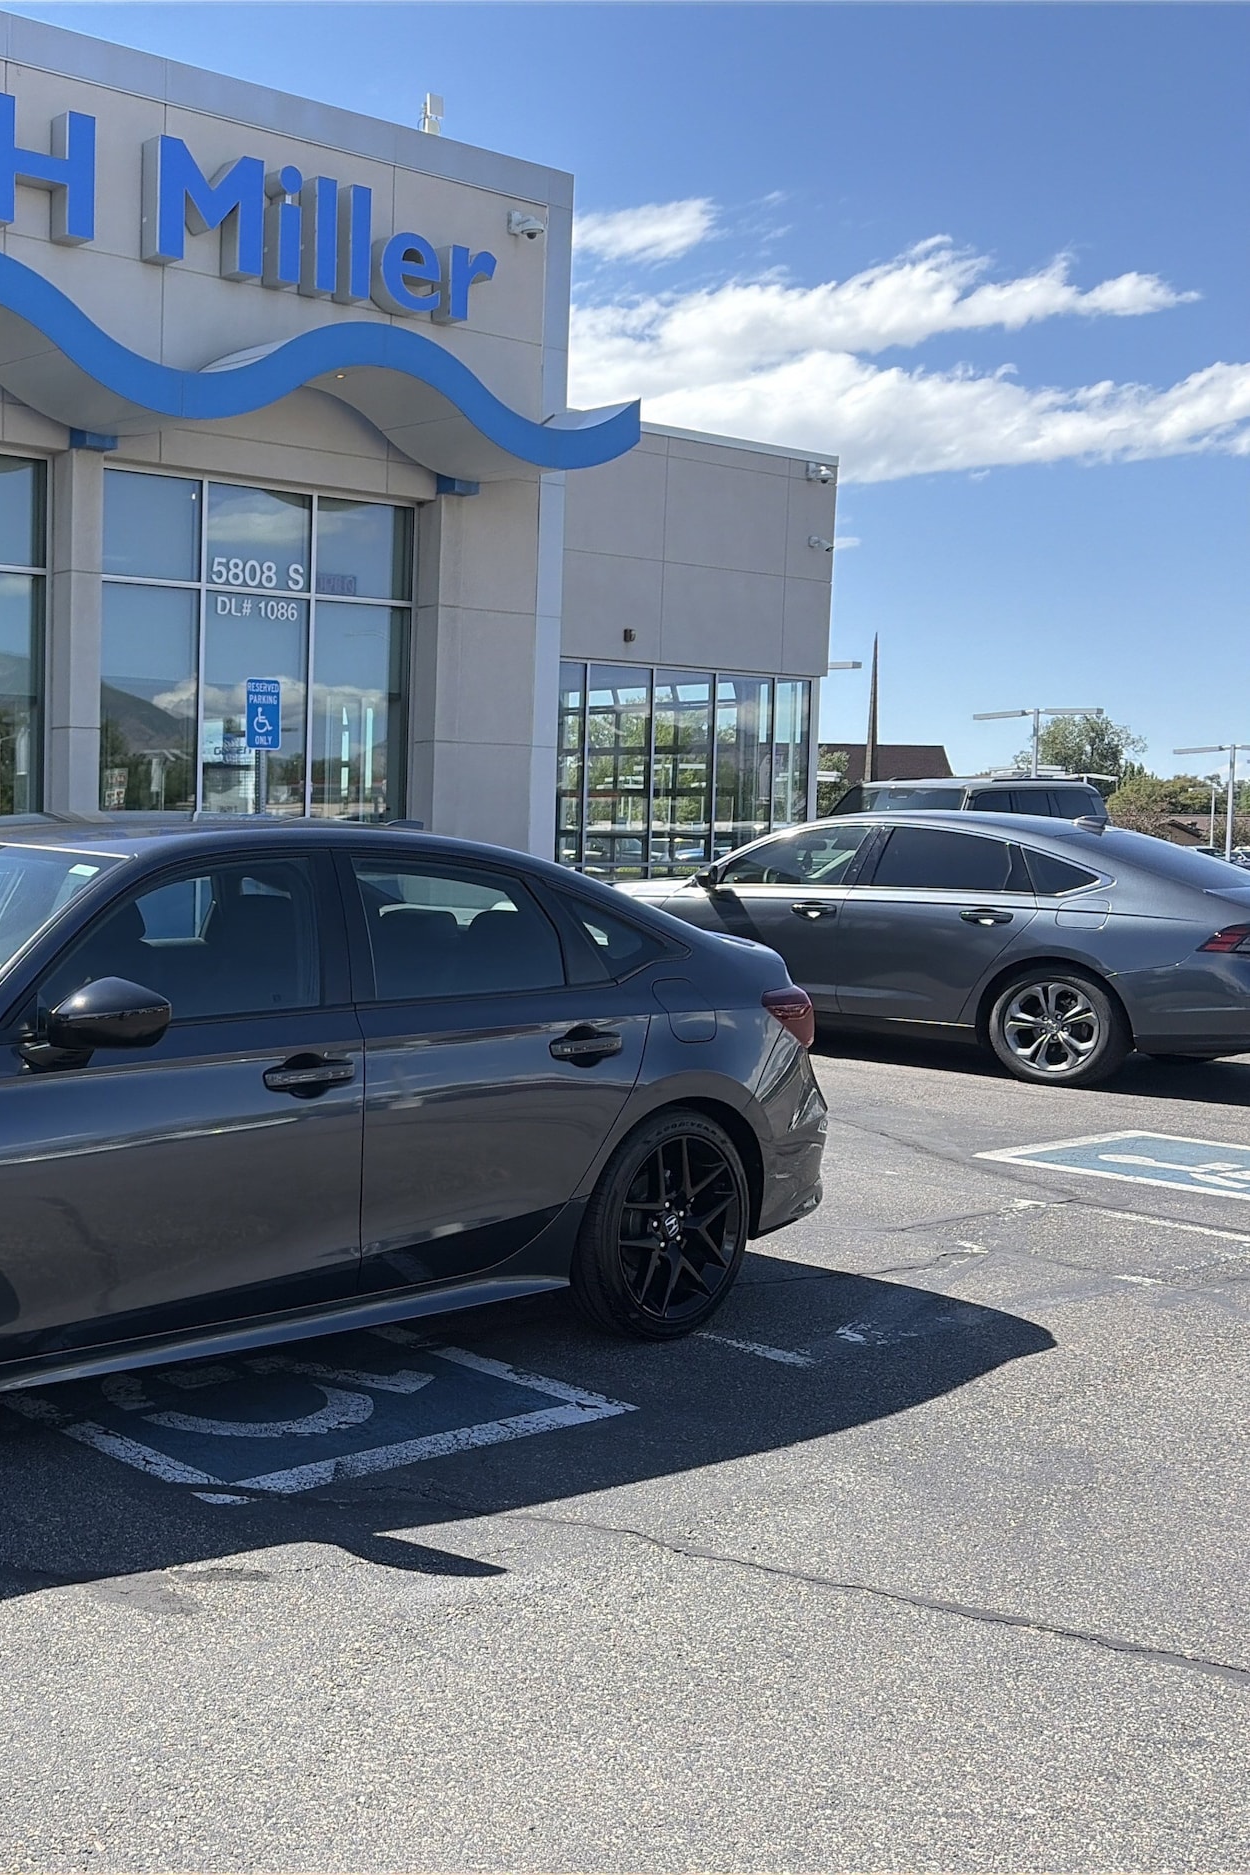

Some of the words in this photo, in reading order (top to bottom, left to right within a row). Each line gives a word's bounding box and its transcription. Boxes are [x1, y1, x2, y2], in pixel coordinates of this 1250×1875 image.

[143, 134, 498, 323] Miller
[211, 557, 277, 588] 5808
[288, 563, 304, 591] S
[216, 596, 252, 617] DL#
[258, 600, 298, 621] 1086
[247, 682, 280, 693] RESERVED
[249, 694, 278, 705] PARKING
[255, 735, 273, 745] ONLY
